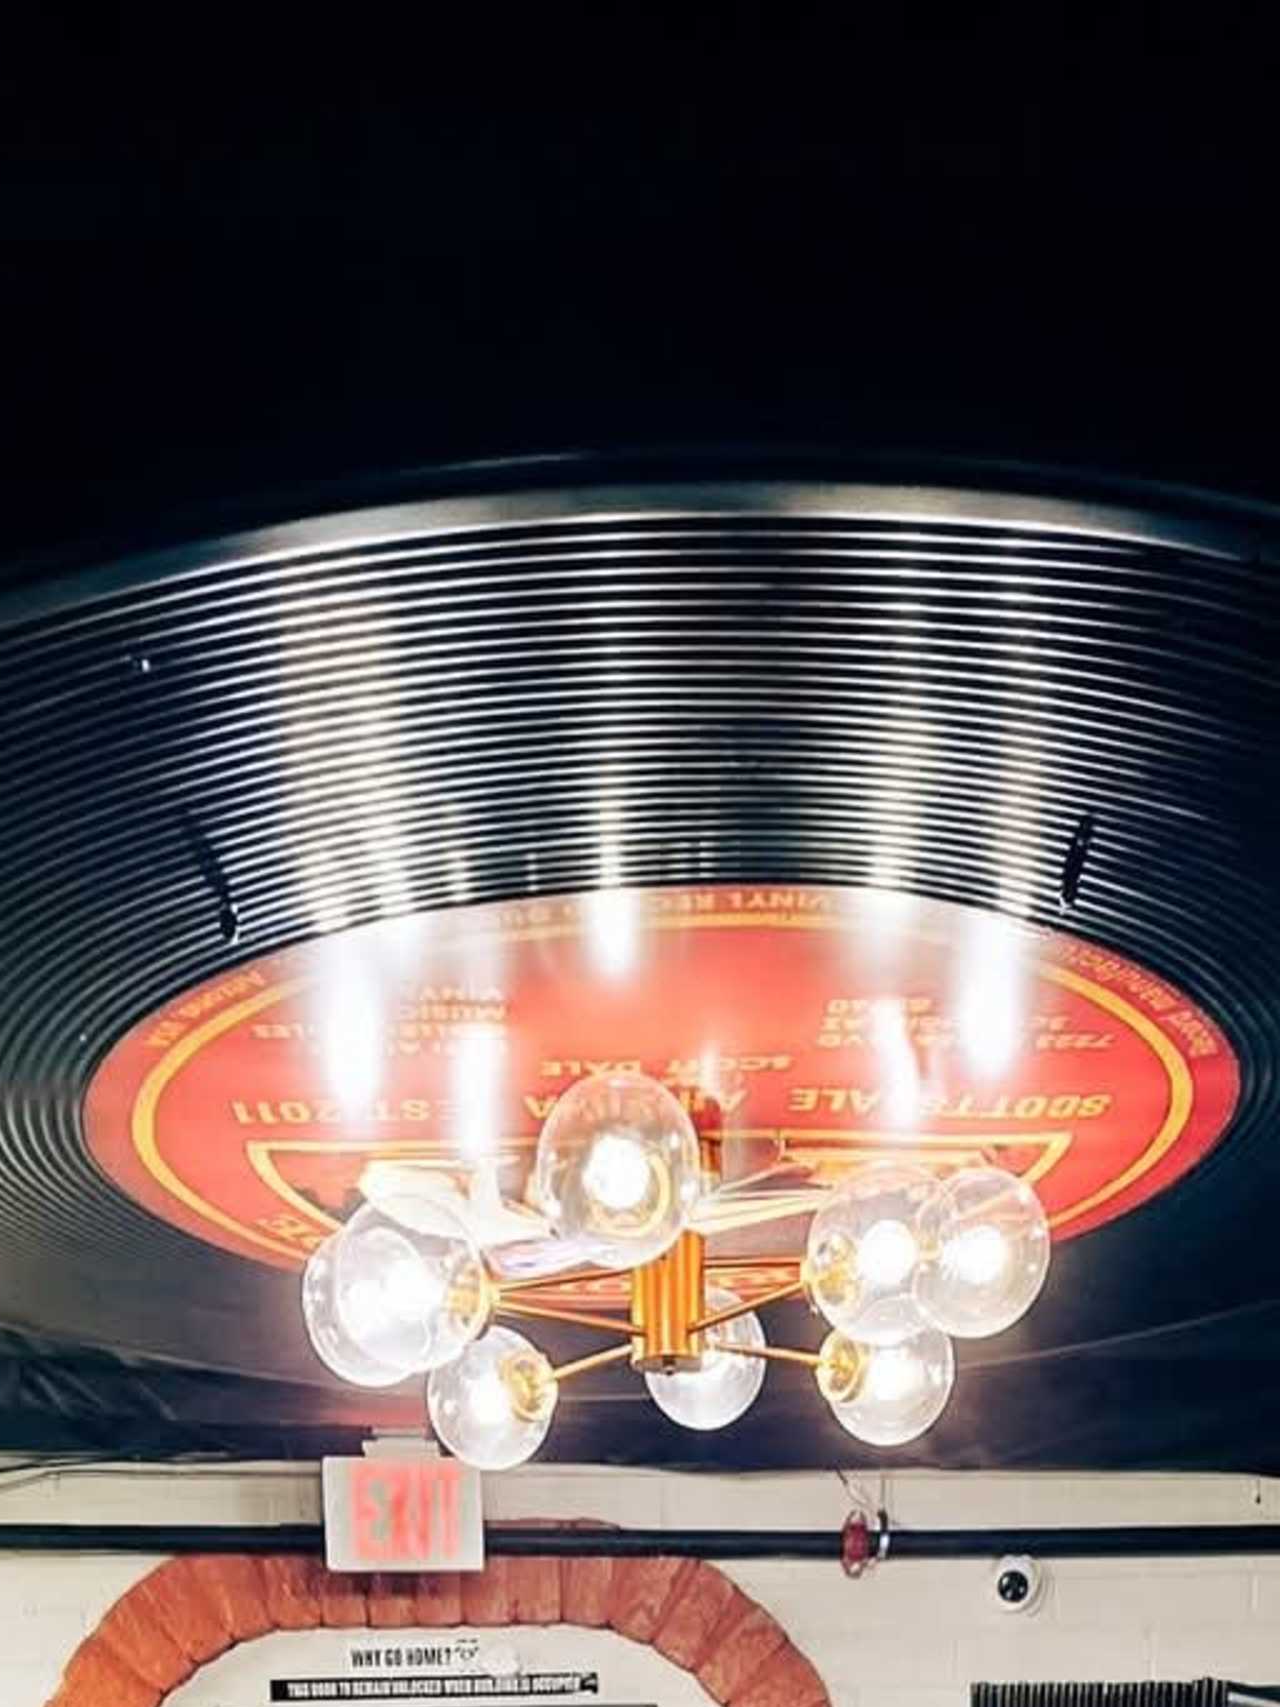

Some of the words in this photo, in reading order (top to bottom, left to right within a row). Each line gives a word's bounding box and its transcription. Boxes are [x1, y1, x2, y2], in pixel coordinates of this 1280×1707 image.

[787, 1087, 1113, 1120] SCOTTSALE
[351, 1462, 461, 1562] EXIT
[350, 1648, 380, 1668] WHY
[384, 1648, 401, 1667] GO
[407, 1646, 451, 1666] HOME?
